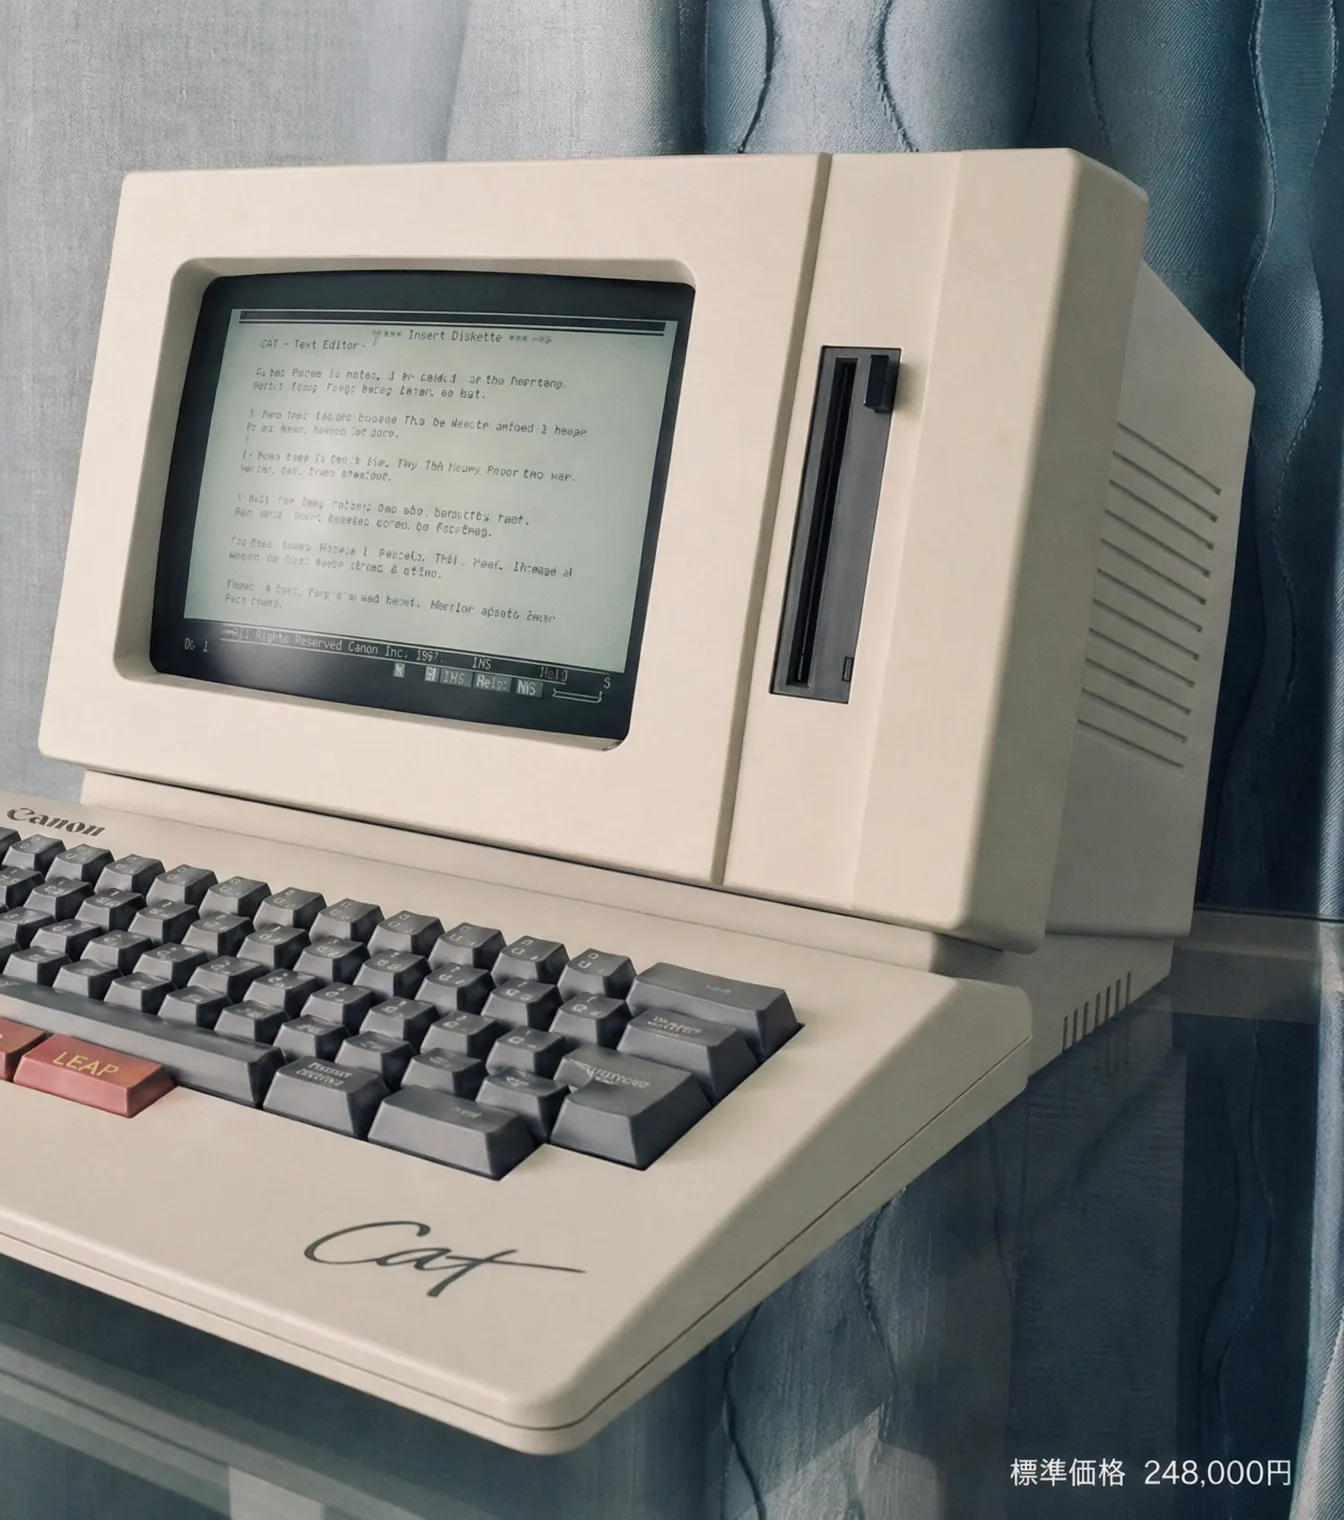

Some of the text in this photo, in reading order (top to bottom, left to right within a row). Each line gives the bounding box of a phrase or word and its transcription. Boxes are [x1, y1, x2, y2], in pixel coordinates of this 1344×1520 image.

[408, 330, 445, 341] Insert
[451, 331, 502, 342] Diskette
[294, 634, 343, 651] Reserved
[348, 641, 378, 655] Canon
[6, 807, 106, 836] Canon
[52, 1051, 120, 1076] LEAP
[304, 1220, 587, 1298] Cat
